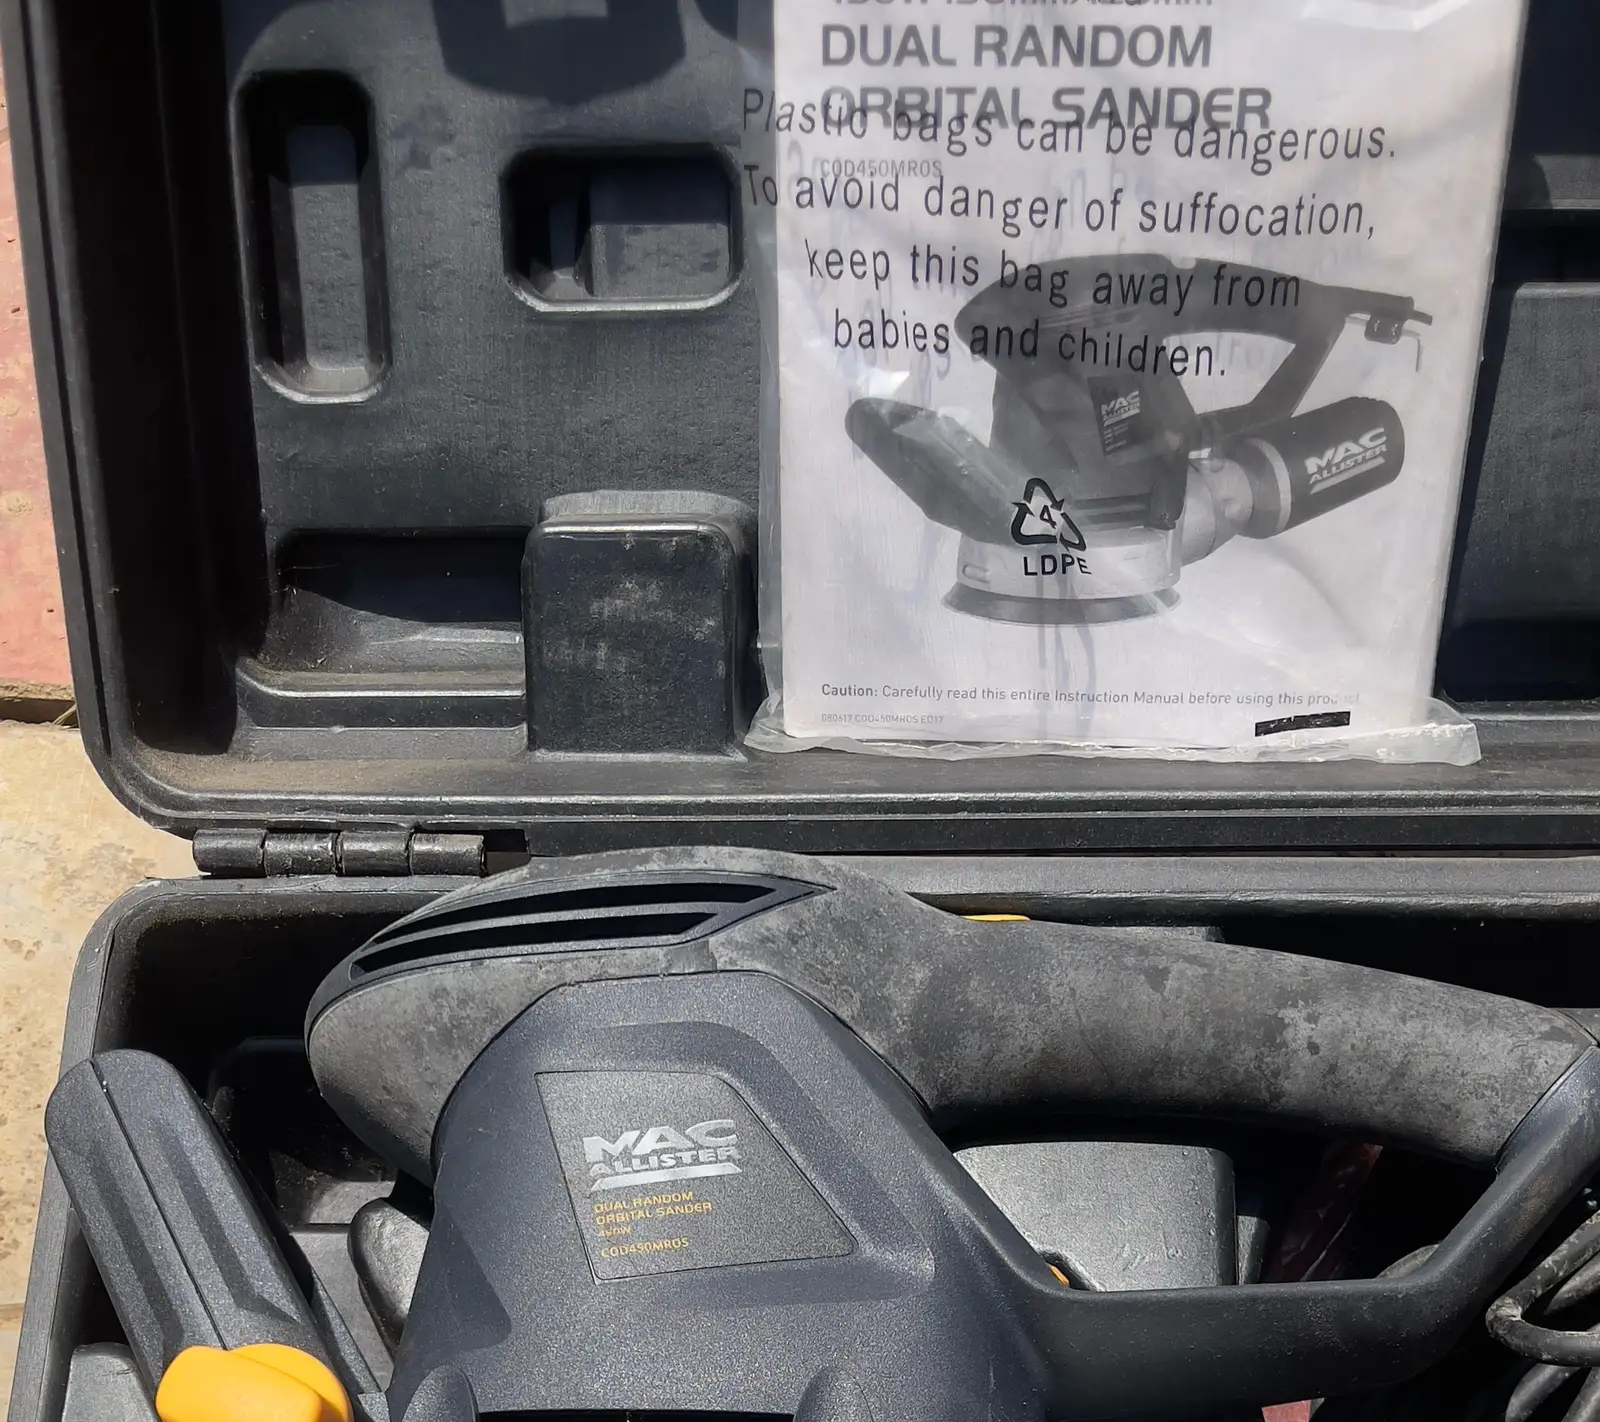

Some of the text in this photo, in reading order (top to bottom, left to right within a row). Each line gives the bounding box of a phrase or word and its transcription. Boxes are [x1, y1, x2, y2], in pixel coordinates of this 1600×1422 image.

[821, 24, 1212, 67] DUAL RANDOM
[820, 86, 1272, 129] ORBITAL SANDER
[743, 88, 1395, 176] Plastic bags can be dangerous.
[743, 164, 1375, 240] To avoid danger of suffocation,
[805, 238, 1300, 317] keep this bag away from
[834, 308, 1226, 377] babies and children.
[1101, 390, 1140, 416] MAC
[1304, 427, 1387, 475] MAC
[1308, 444, 1388, 484] ALLISTER
[1023, 553, 1092, 576] LDPE
[821, 684, 878, 697] Caution:
[882, 685, 943, 701] Carefully
[947, 687, 977, 700] read
[981, 688, 1006, 700] this
[1010, 689, 1051, 701] entire
[1055, 689, 1129, 703] Instruction
[1134, 691, 1184, 704] Manual
[1189, 692, 1231, 705] before
[1236, 693, 1273, 707] using
[1278, 692, 1303, 705] this
[582, 1119, 740, 1162] MAC
[589, 1147, 741, 1176] ALLISTER
[593, 1191, 693, 1214] DUAL RANDOM
[595, 1202, 712, 1226] ORBITAL SANDER
